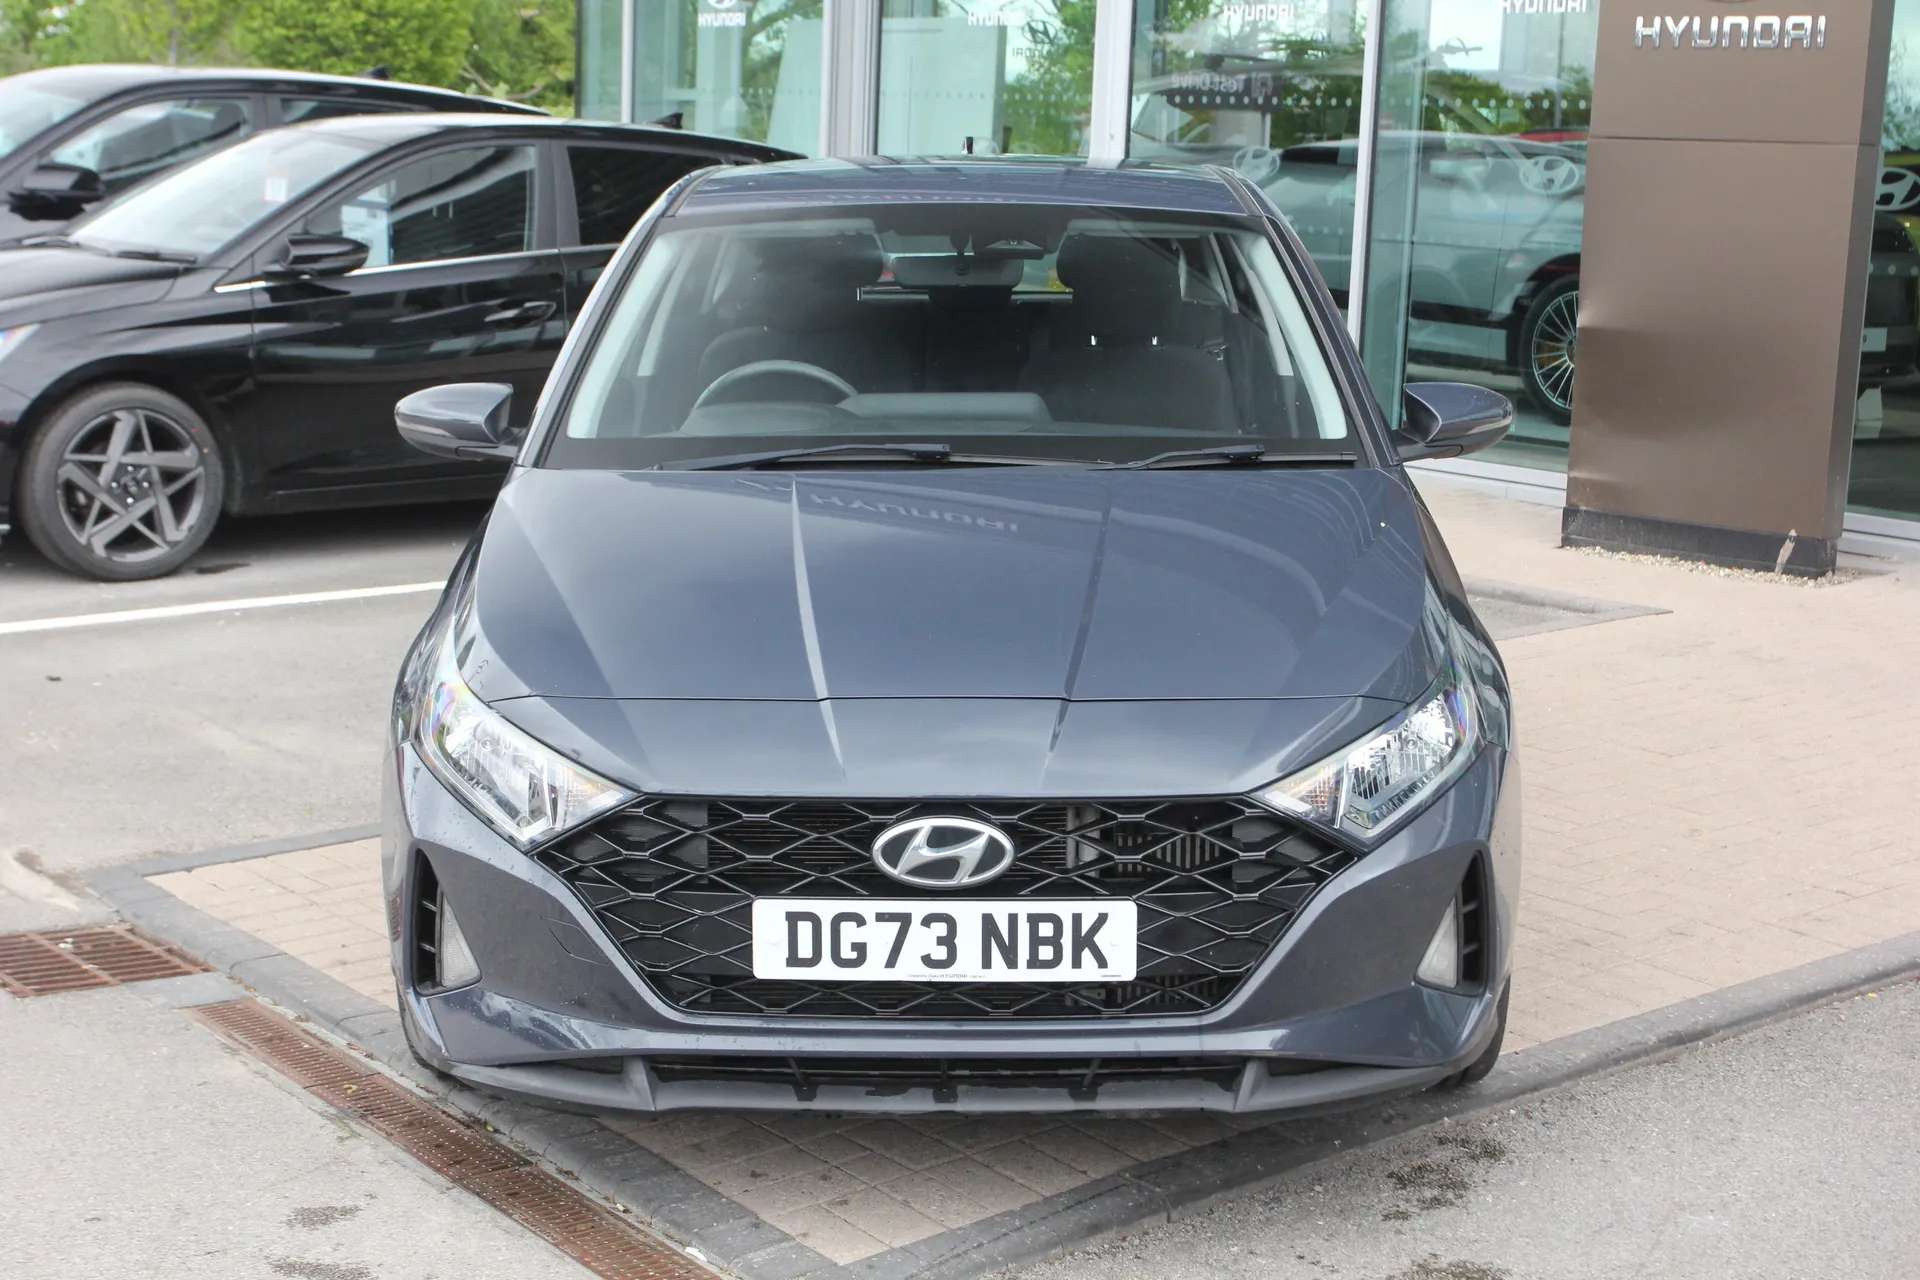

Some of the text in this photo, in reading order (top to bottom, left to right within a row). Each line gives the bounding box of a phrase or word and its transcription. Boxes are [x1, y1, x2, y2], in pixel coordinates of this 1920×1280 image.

[1224, 5, 1294, 20] HYUNDAI
[1498, 0, 1587, 13] HYUNDAI
[698, 12, 746, 27] HYUNDAI
[1635, 15, 1826, 48] HYUNDAI
[785, 911, 1108, 969] DG73 NBK
